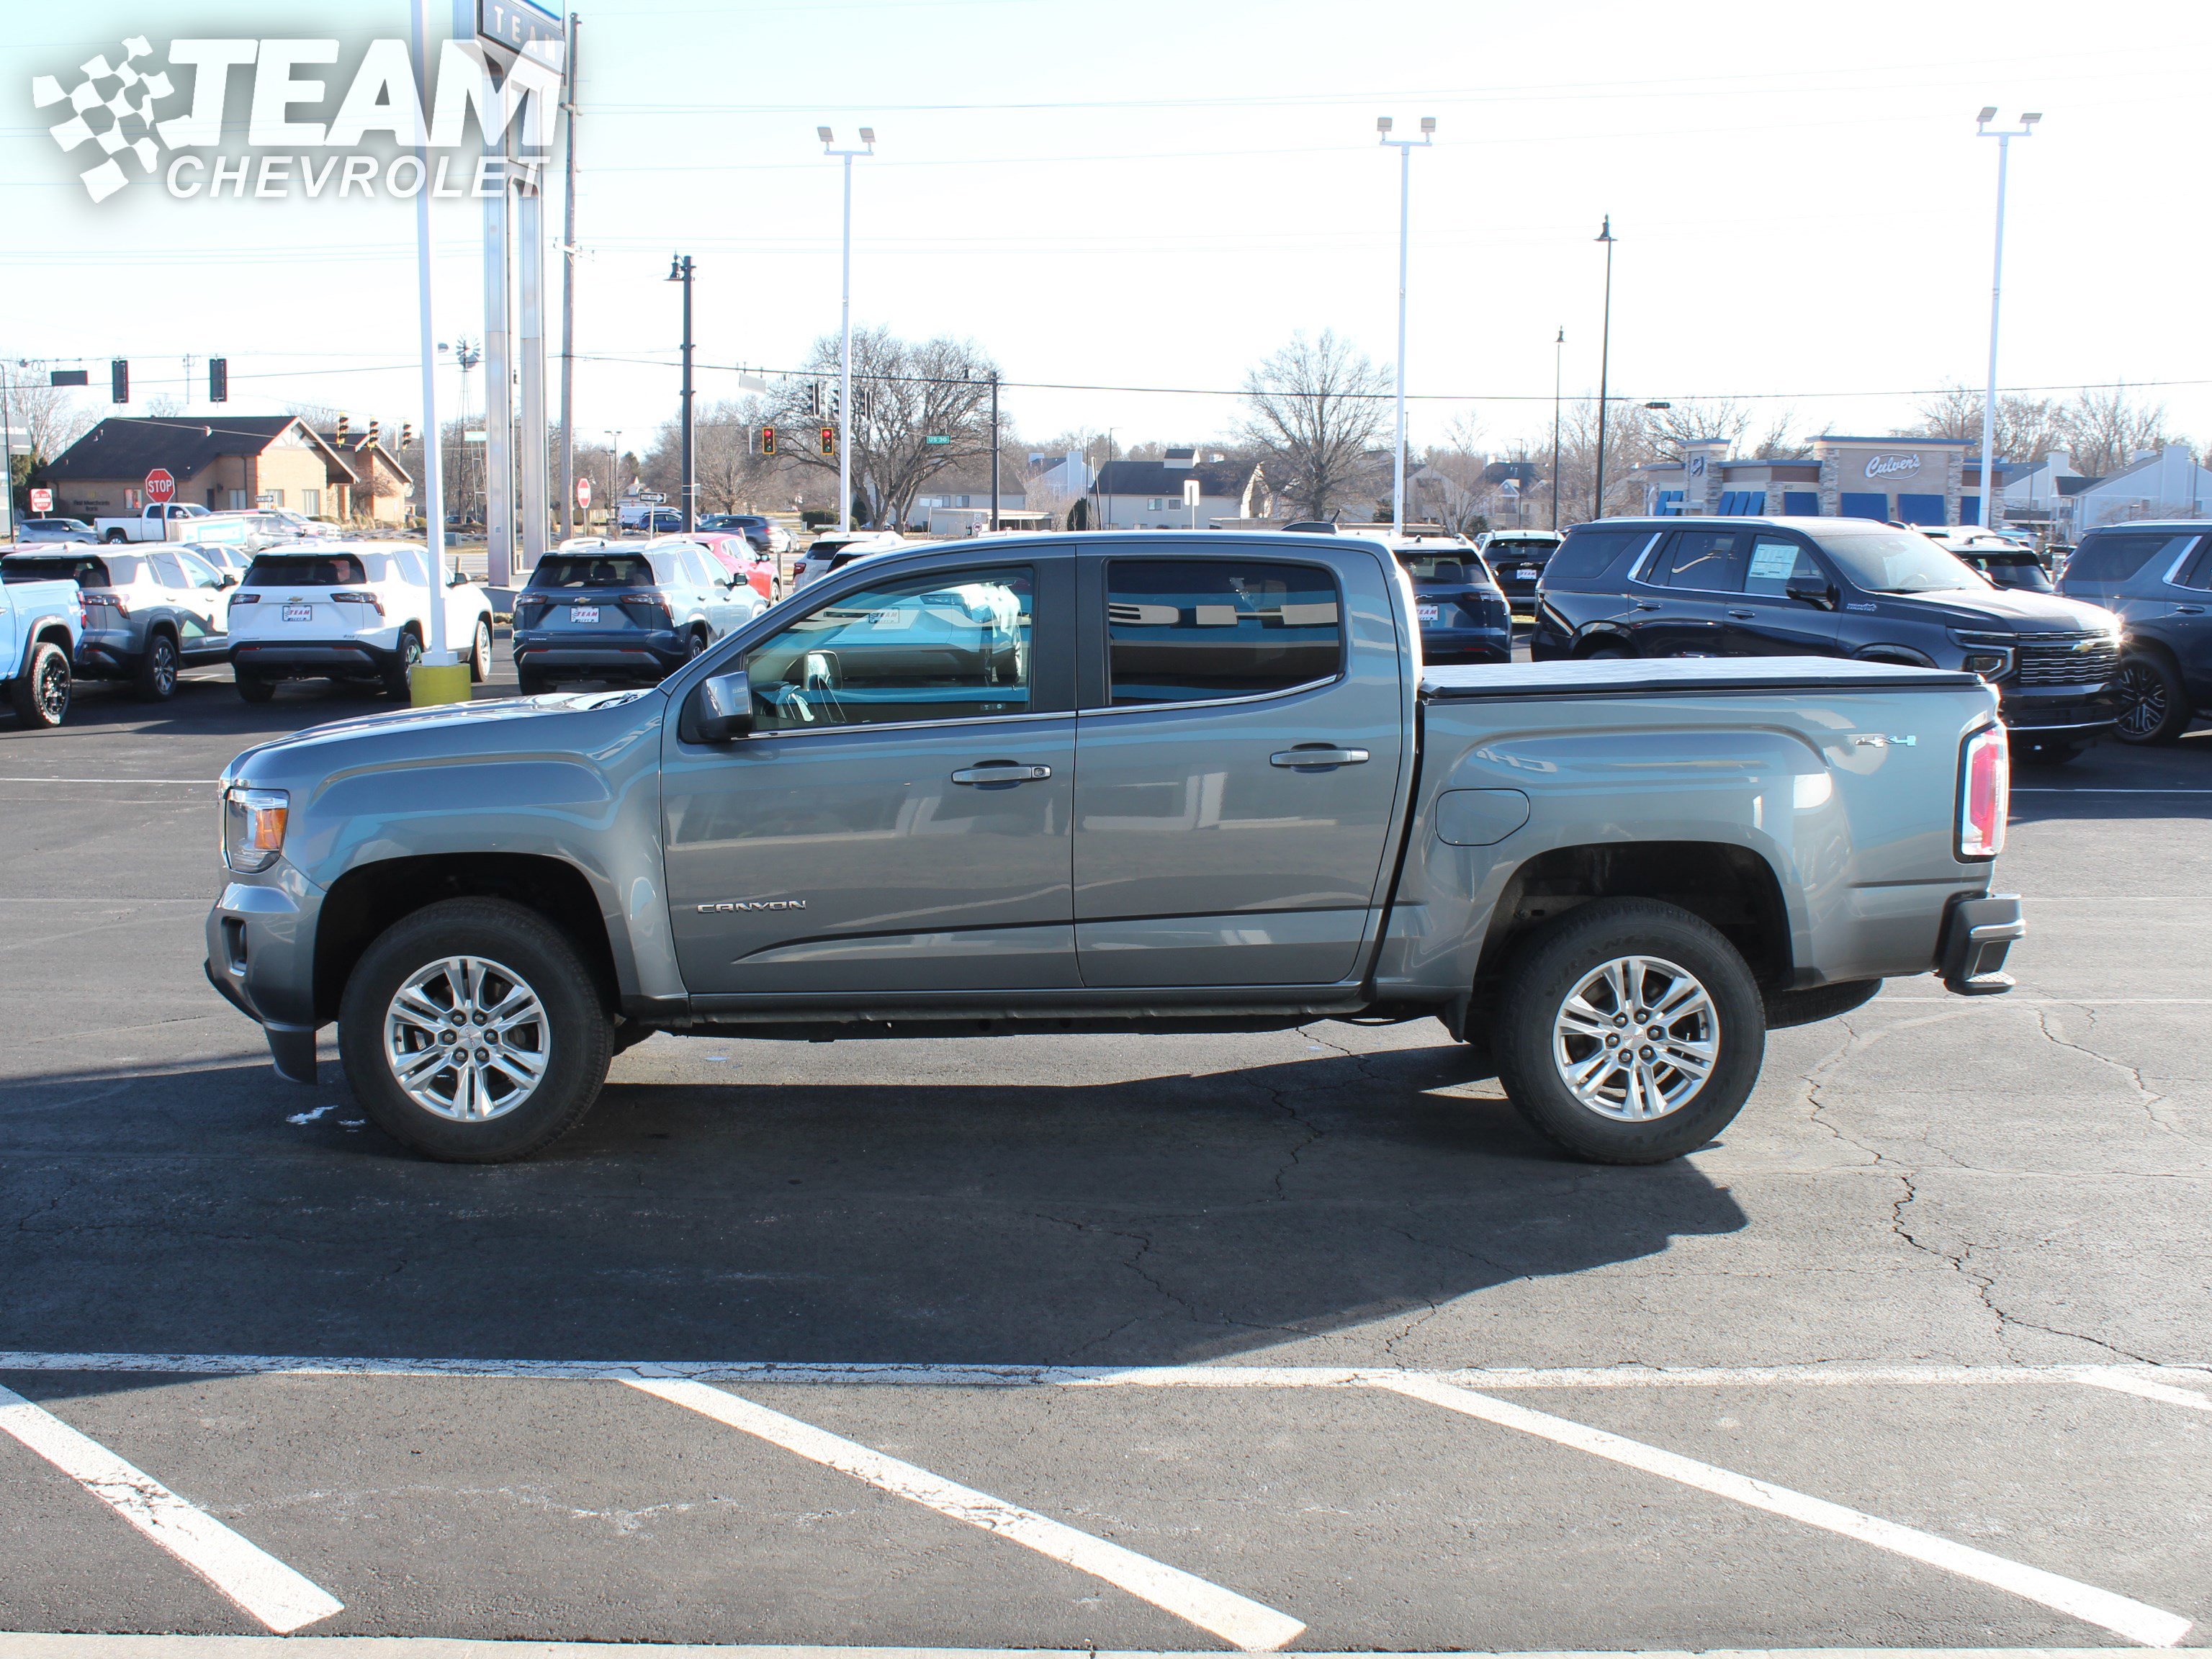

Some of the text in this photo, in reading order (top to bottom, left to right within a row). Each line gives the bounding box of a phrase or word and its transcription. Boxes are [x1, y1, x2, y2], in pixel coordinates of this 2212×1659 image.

[494, 5, 556, 62] TEAM
[1865, 453, 1922, 479] Culver's
[148, 480, 172, 493] STOP
[697, 900, 806, 914] CANYON
